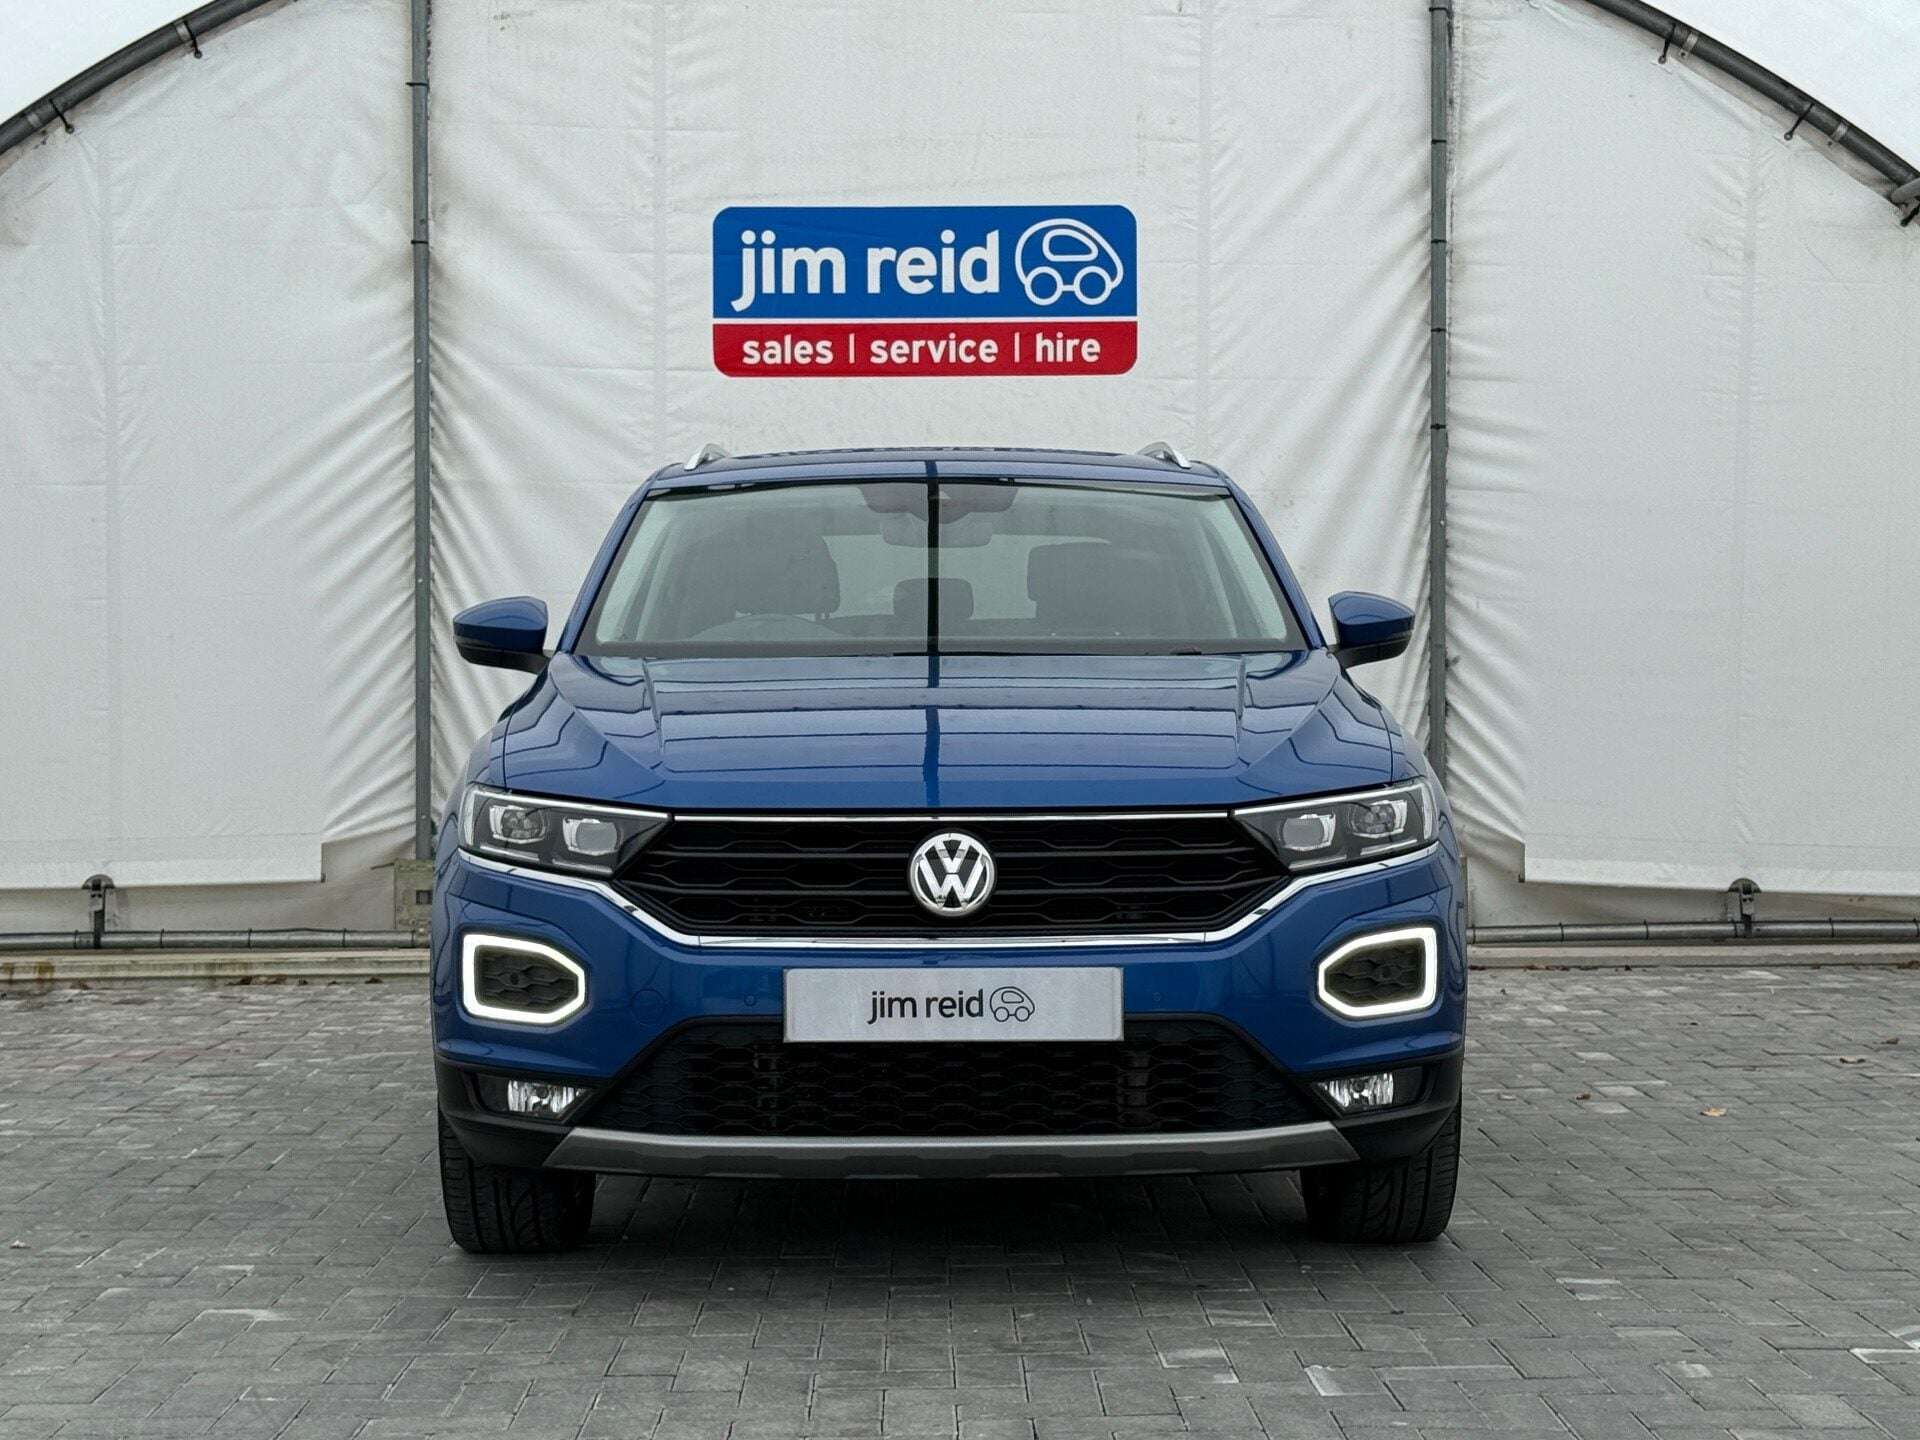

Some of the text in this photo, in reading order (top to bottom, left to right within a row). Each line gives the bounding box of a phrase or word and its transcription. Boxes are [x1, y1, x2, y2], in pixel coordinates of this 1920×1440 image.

[730, 229, 1000, 312] jim reid
[742, 331, 1101, 365] sales service hire
[866, 988, 984, 1025] jim reid
